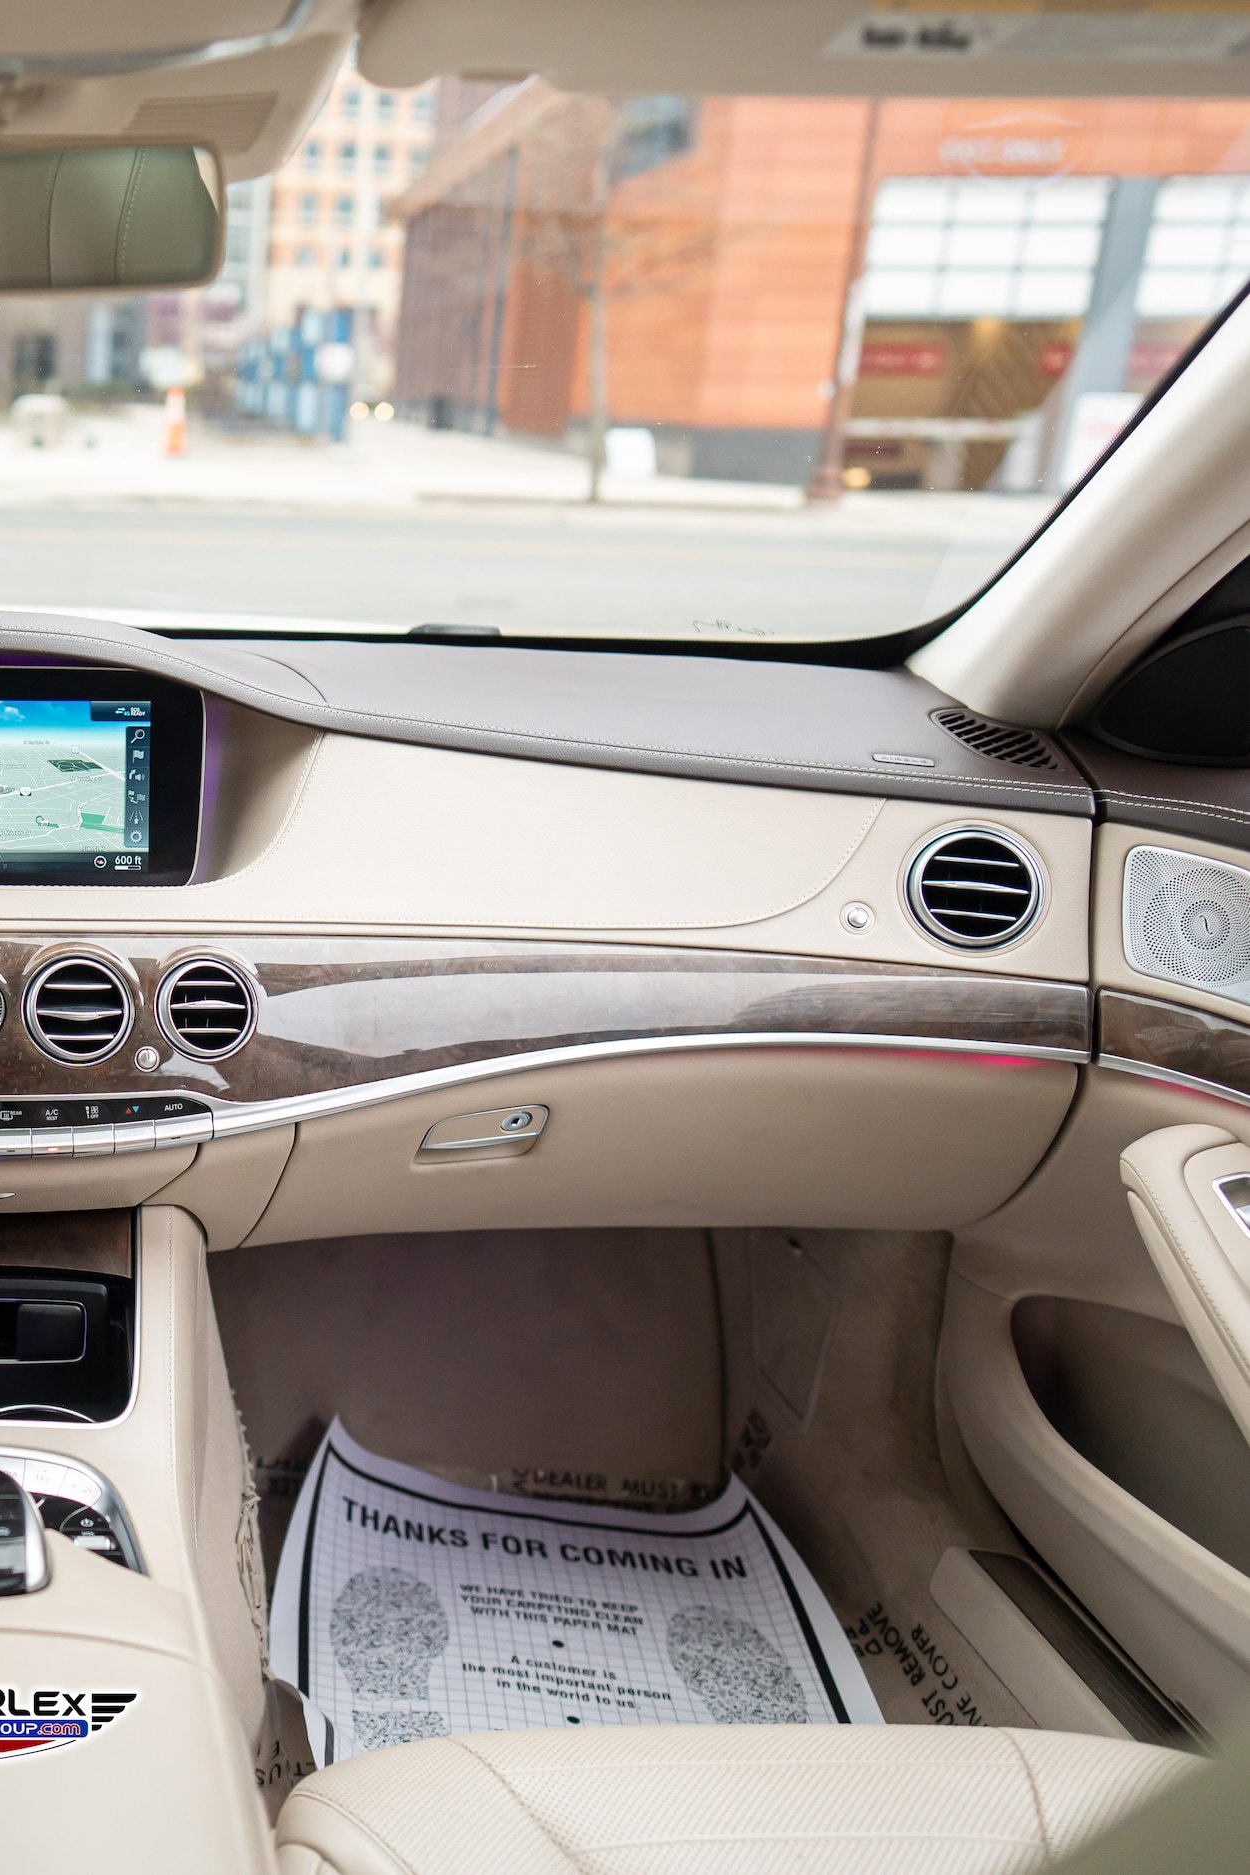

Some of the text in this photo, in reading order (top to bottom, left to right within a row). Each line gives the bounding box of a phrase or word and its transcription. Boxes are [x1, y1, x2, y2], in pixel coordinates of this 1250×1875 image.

[115, 856, 142, 865] 600 ft
[164, 1103, 184, 1112] AUTO
[533, 1469, 608, 1490] DEALER
[621, 1478, 679, 1498] MUST
[342, 1496, 747, 1580] THANKS FOR COMING IN
[460, 1584, 639, 1613] WE HAVE TRIED TO KEEP
[460, 1595, 644, 1626] YOUR CARPETING CLEAN
[470, 1606, 638, 1636] WITH THIS PAPER MAT
[511, 1656, 617, 1680] A customer is
[866, 1601, 955, 1726] UST REMOVE
[462, 1663, 672, 1701] the most important person
[496, 1679, 510, 1688] in
[516, 1680, 541, 1694] the
[546, 1688, 590, 1702] world
[596, 1695, 611, 1706] to
